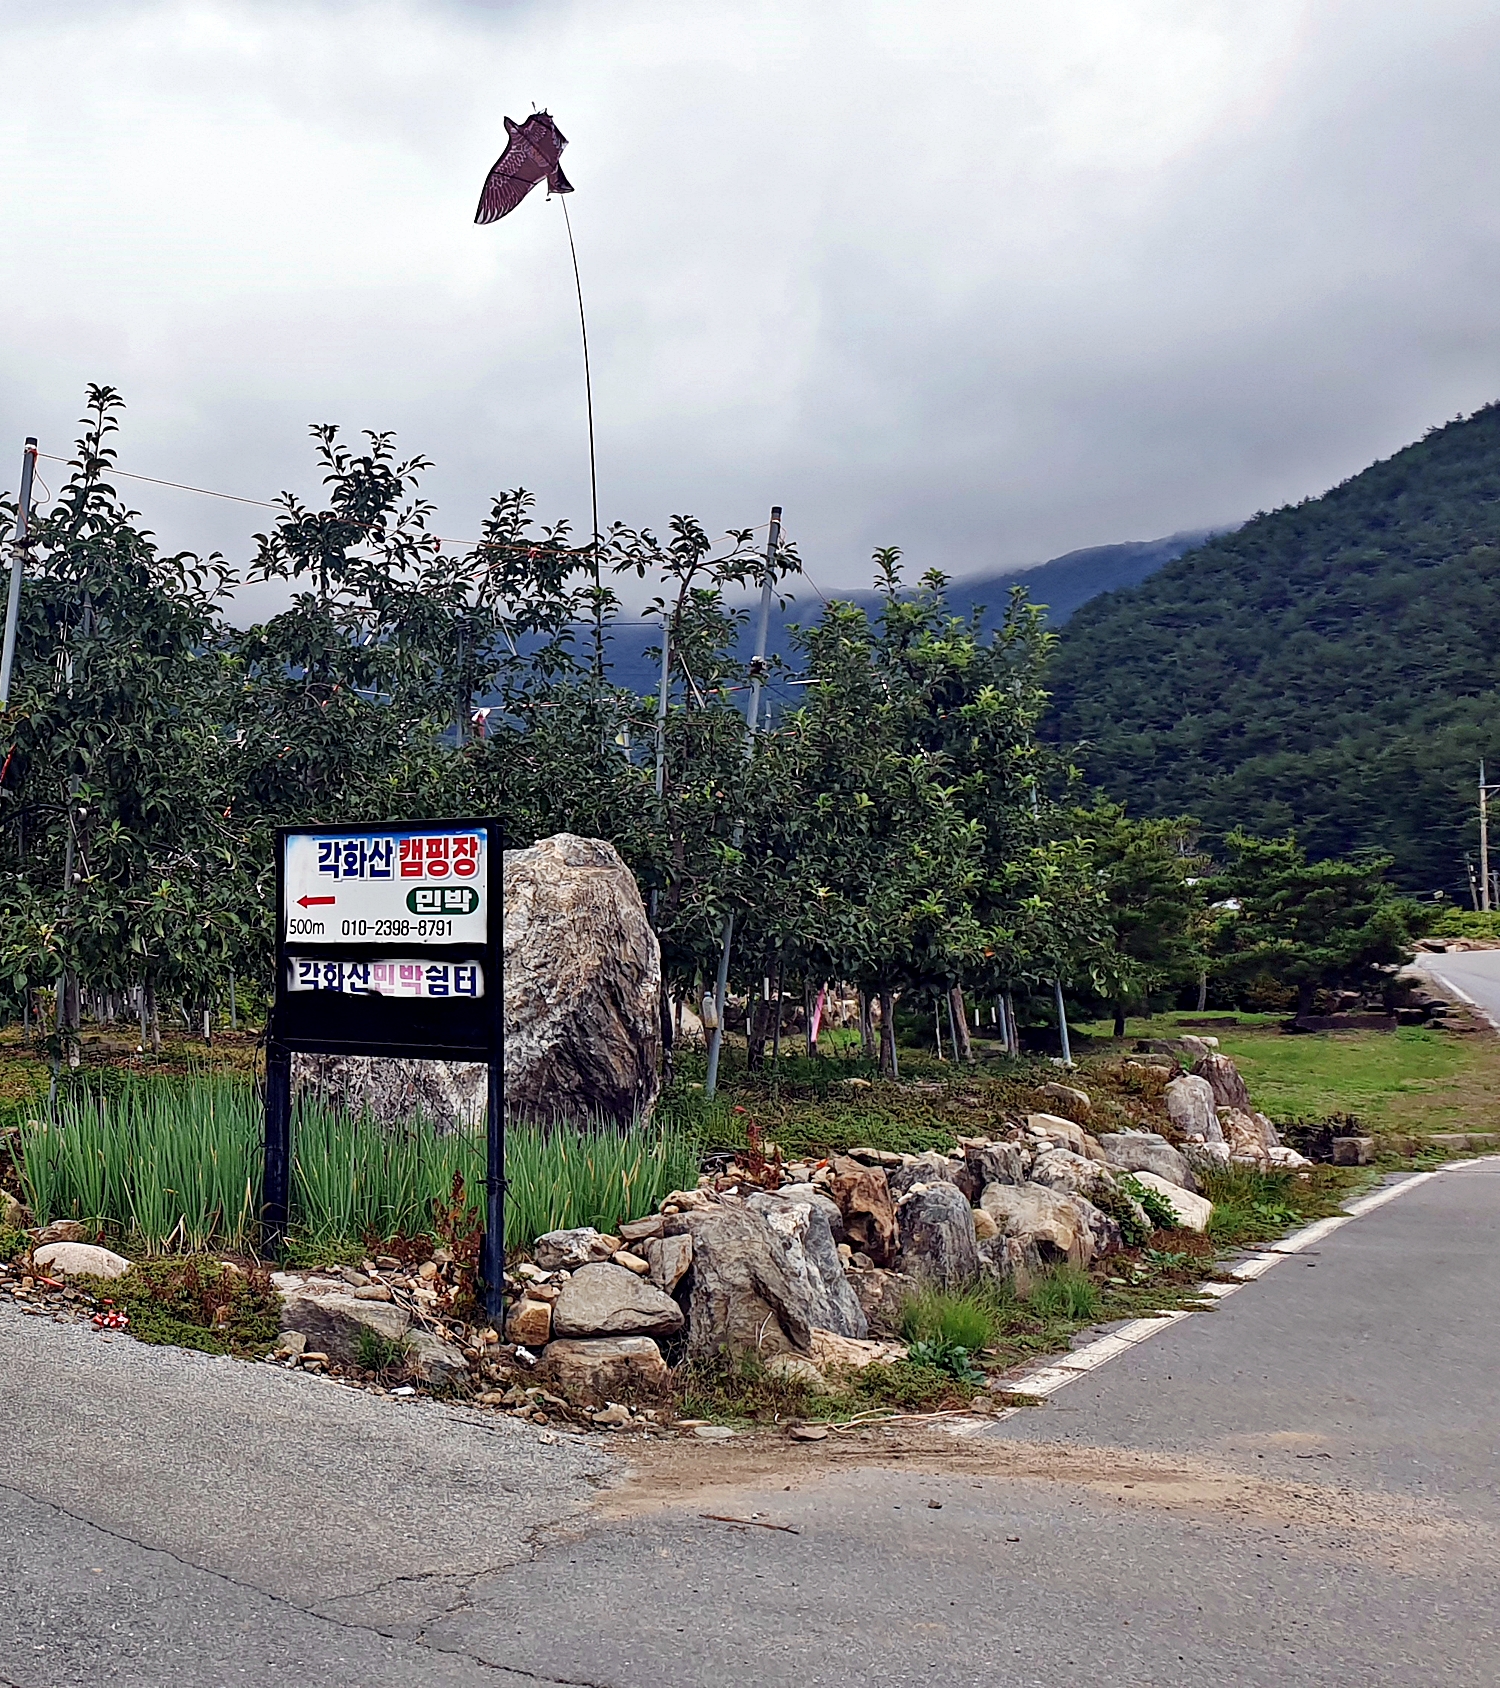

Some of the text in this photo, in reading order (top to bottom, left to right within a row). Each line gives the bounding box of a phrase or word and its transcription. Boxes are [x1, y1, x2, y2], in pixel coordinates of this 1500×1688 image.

[318, 836, 478, 879] 각화산 캠핑장
[415, 889, 472, 912] 민박
[289, 919, 453, 936] 500m 010-2398-8791
